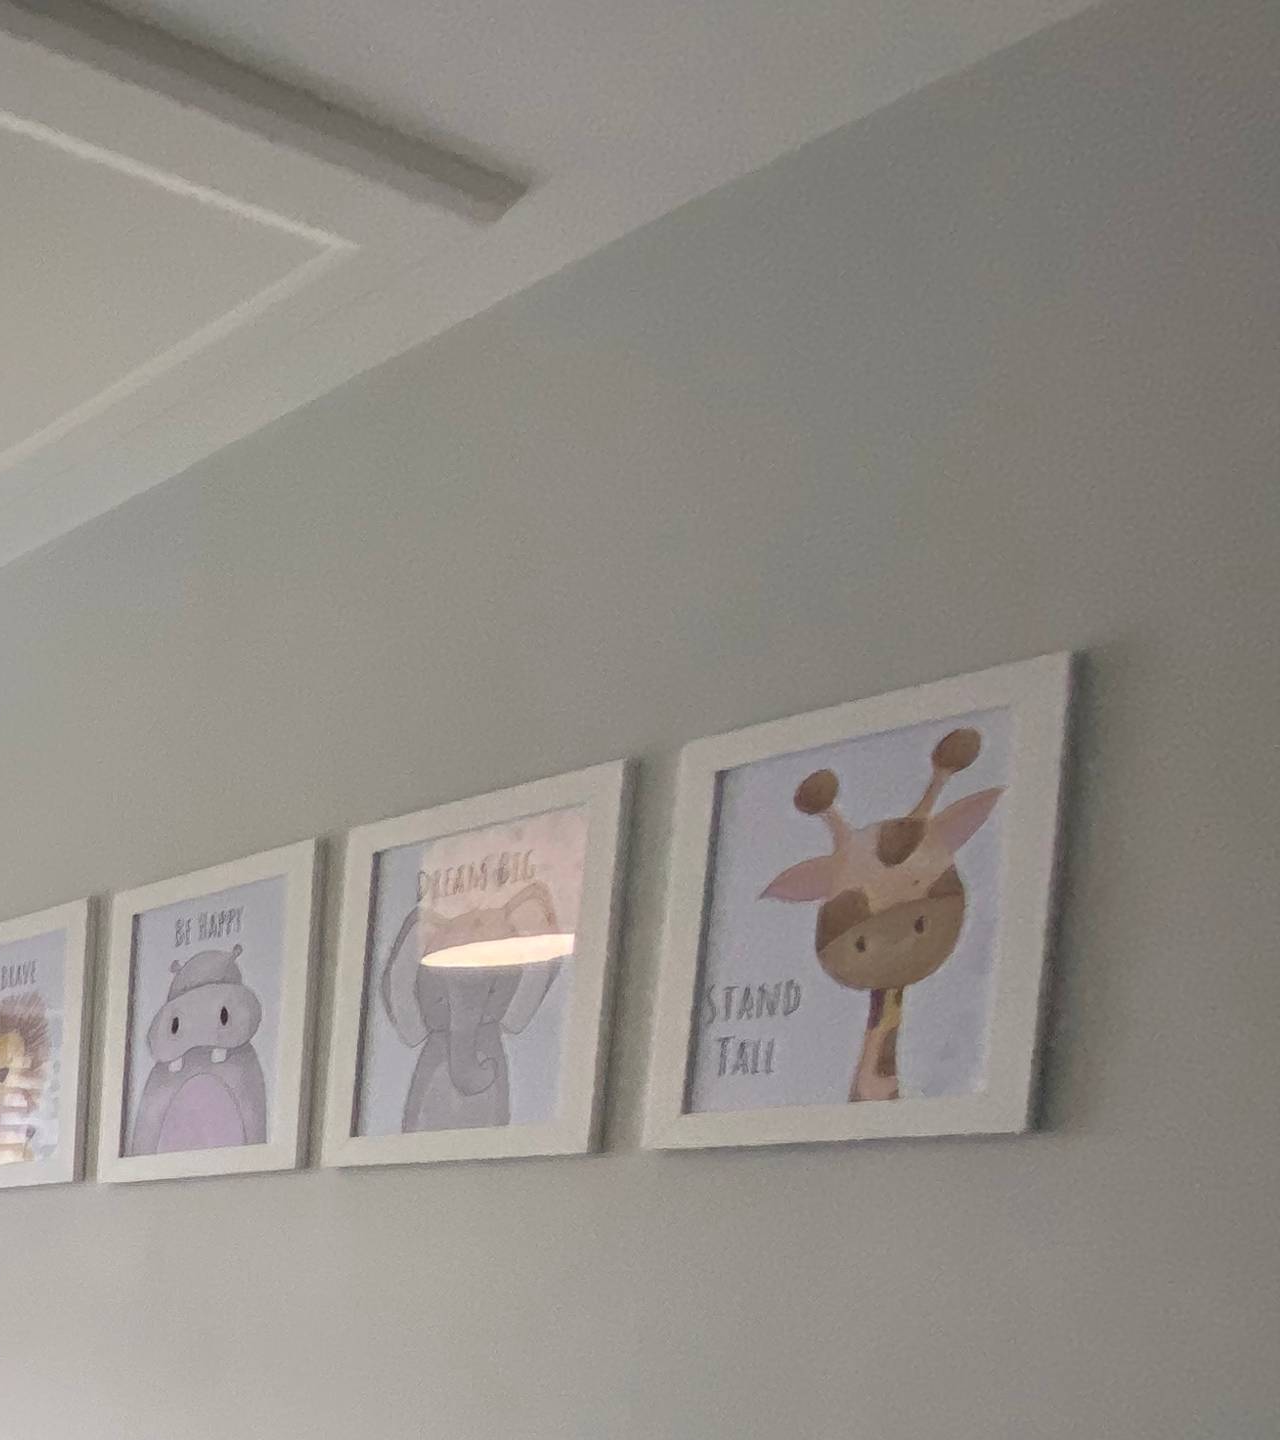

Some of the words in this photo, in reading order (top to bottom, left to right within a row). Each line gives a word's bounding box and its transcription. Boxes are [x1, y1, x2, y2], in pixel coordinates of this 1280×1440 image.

[497, 849, 536, 888] BIG
[175, 918, 192, 948] BE
[199, 904, 245, 941] HAPPY
[703, 979, 802, 1025] STAND
[718, 1035, 775, 1076] TALL
